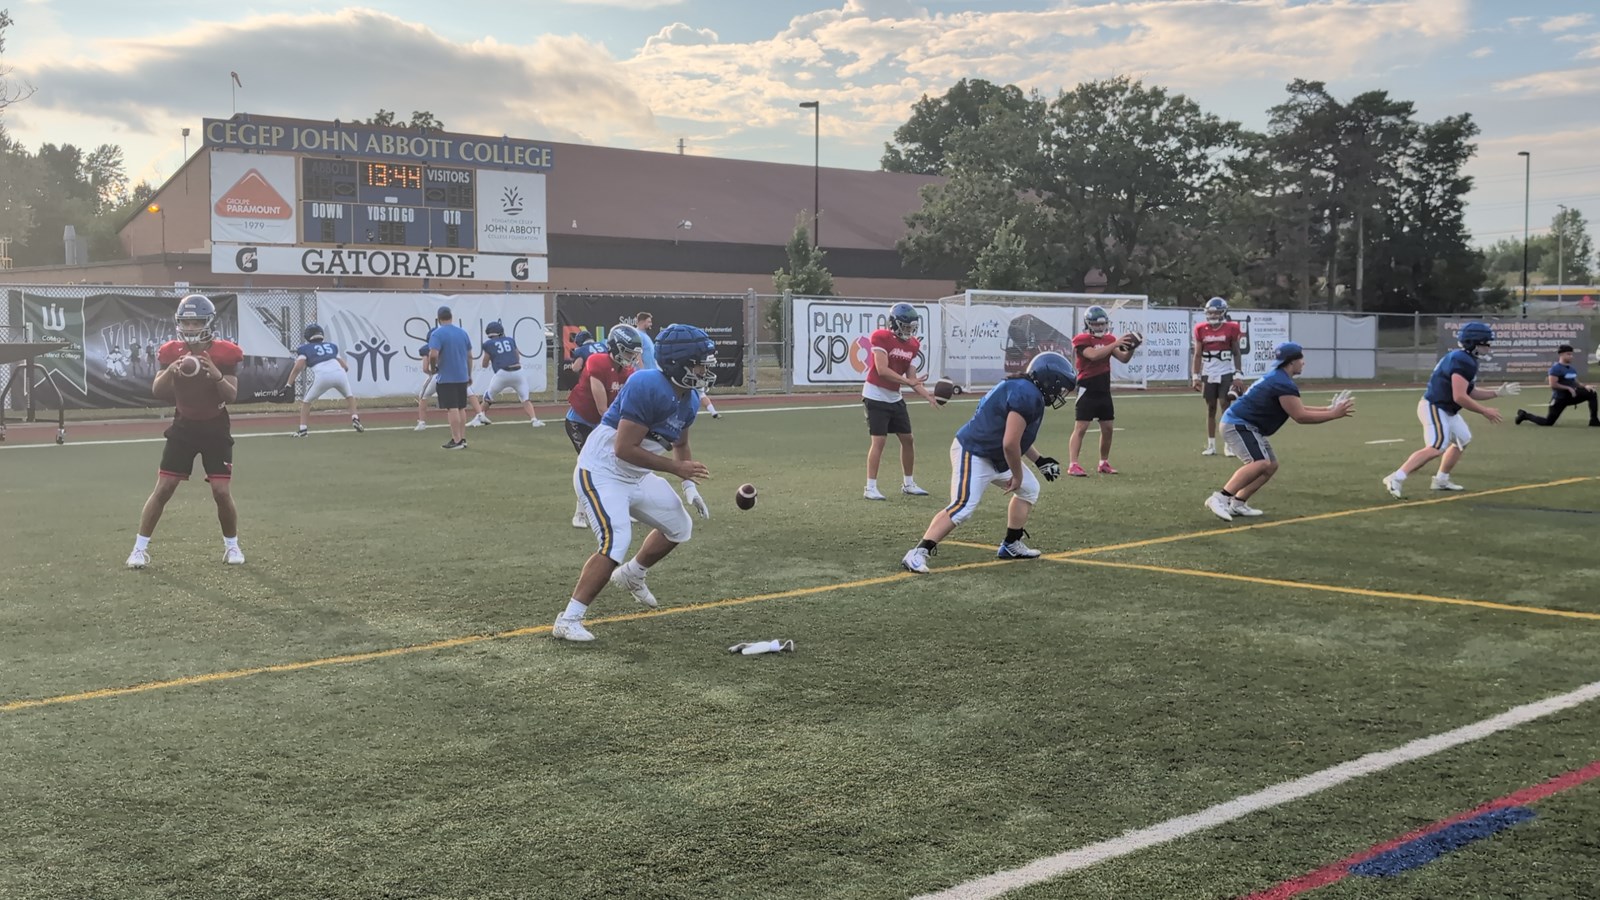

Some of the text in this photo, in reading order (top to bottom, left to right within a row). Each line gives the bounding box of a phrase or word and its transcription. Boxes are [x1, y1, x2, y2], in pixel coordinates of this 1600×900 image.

[207, 121, 552, 168] CEGEP JOHN ABBOTT COLLEGE
[368, 164, 421, 189] 13:44
[427, 169, 470, 184] VISITORS
[226, 204, 281, 215] PARAMOUNT
[312, 203, 343, 219] DOWN
[367, 206, 415, 223] YDS TO GO
[244, 221, 265, 229] 1979
[443, 210, 462, 225] QTR
[484, 224, 542, 235] JOHN ABBOTT
[302, 249, 475, 279] GATORADE
[814, 312, 853, 333] PLAY
[860, 313, 873, 333] IT
[314, 342, 334, 356] 35
[494, 340, 512, 354] 36
[589, 343, 604, 353] 45
[1254, 352, 1277, 361] ORCHAR
